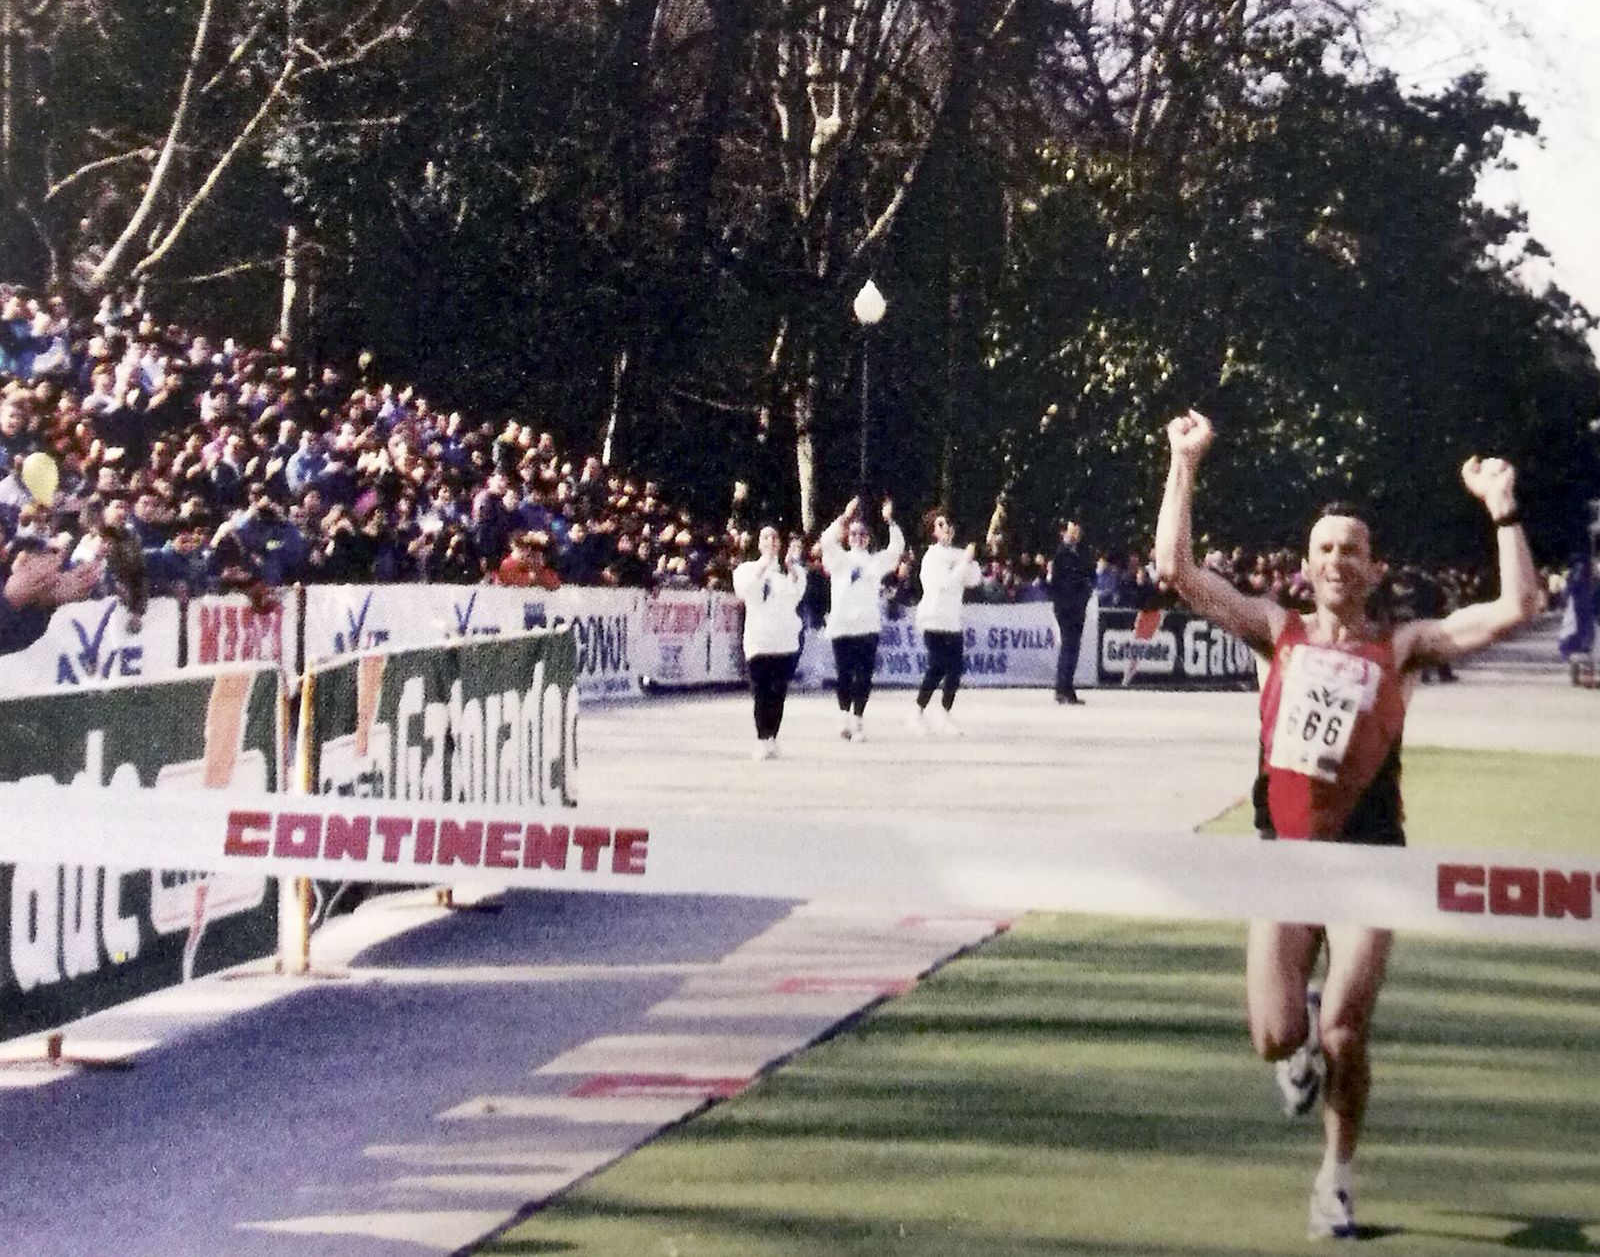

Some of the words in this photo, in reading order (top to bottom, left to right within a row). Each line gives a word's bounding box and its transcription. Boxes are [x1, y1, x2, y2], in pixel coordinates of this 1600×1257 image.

[987, 627, 1055, 650] SEVILLA
[223, 810, 650, 875] CONTINENTE
[1436, 863, 1600, 920] CON
